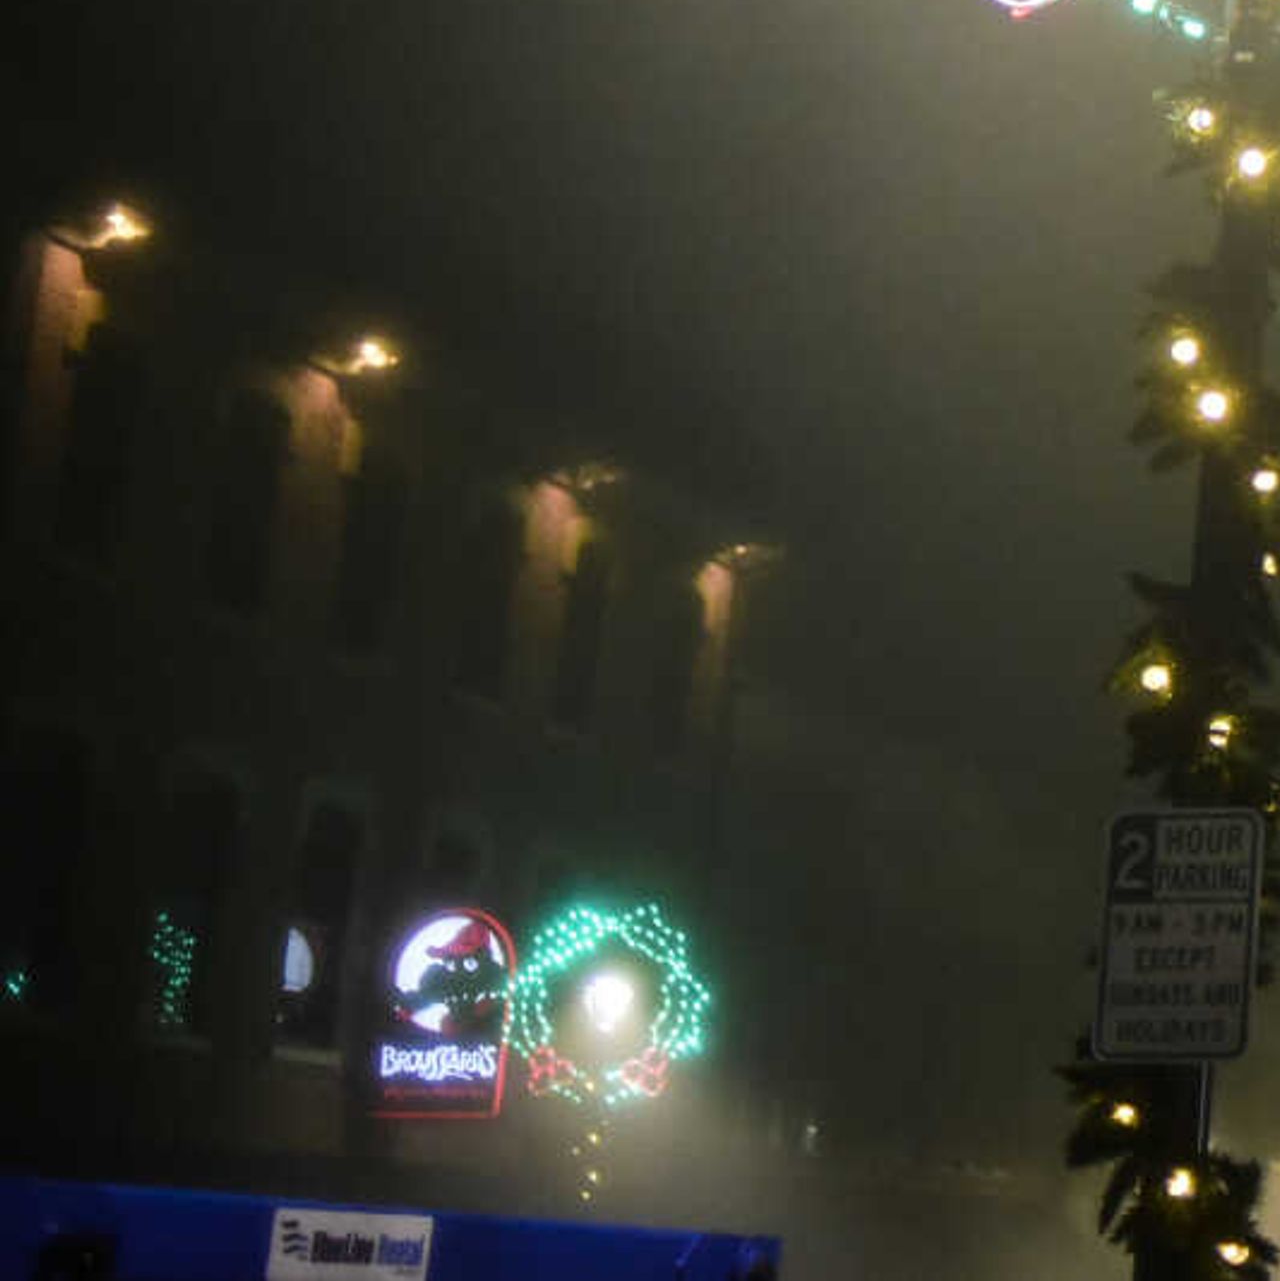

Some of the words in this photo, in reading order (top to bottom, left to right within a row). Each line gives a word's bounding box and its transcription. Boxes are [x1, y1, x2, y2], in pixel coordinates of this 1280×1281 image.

[1113, 831, 1150, 889] 2
[1166, 826, 1243, 855] HOUR
[1154, 865, 1247, 892] PARKING
[1135, 945, 1214, 973] EXCEPT
[1204, 983, 1242, 1005] AND
[1115, 1019, 1225, 1043] HOLIDAYS
